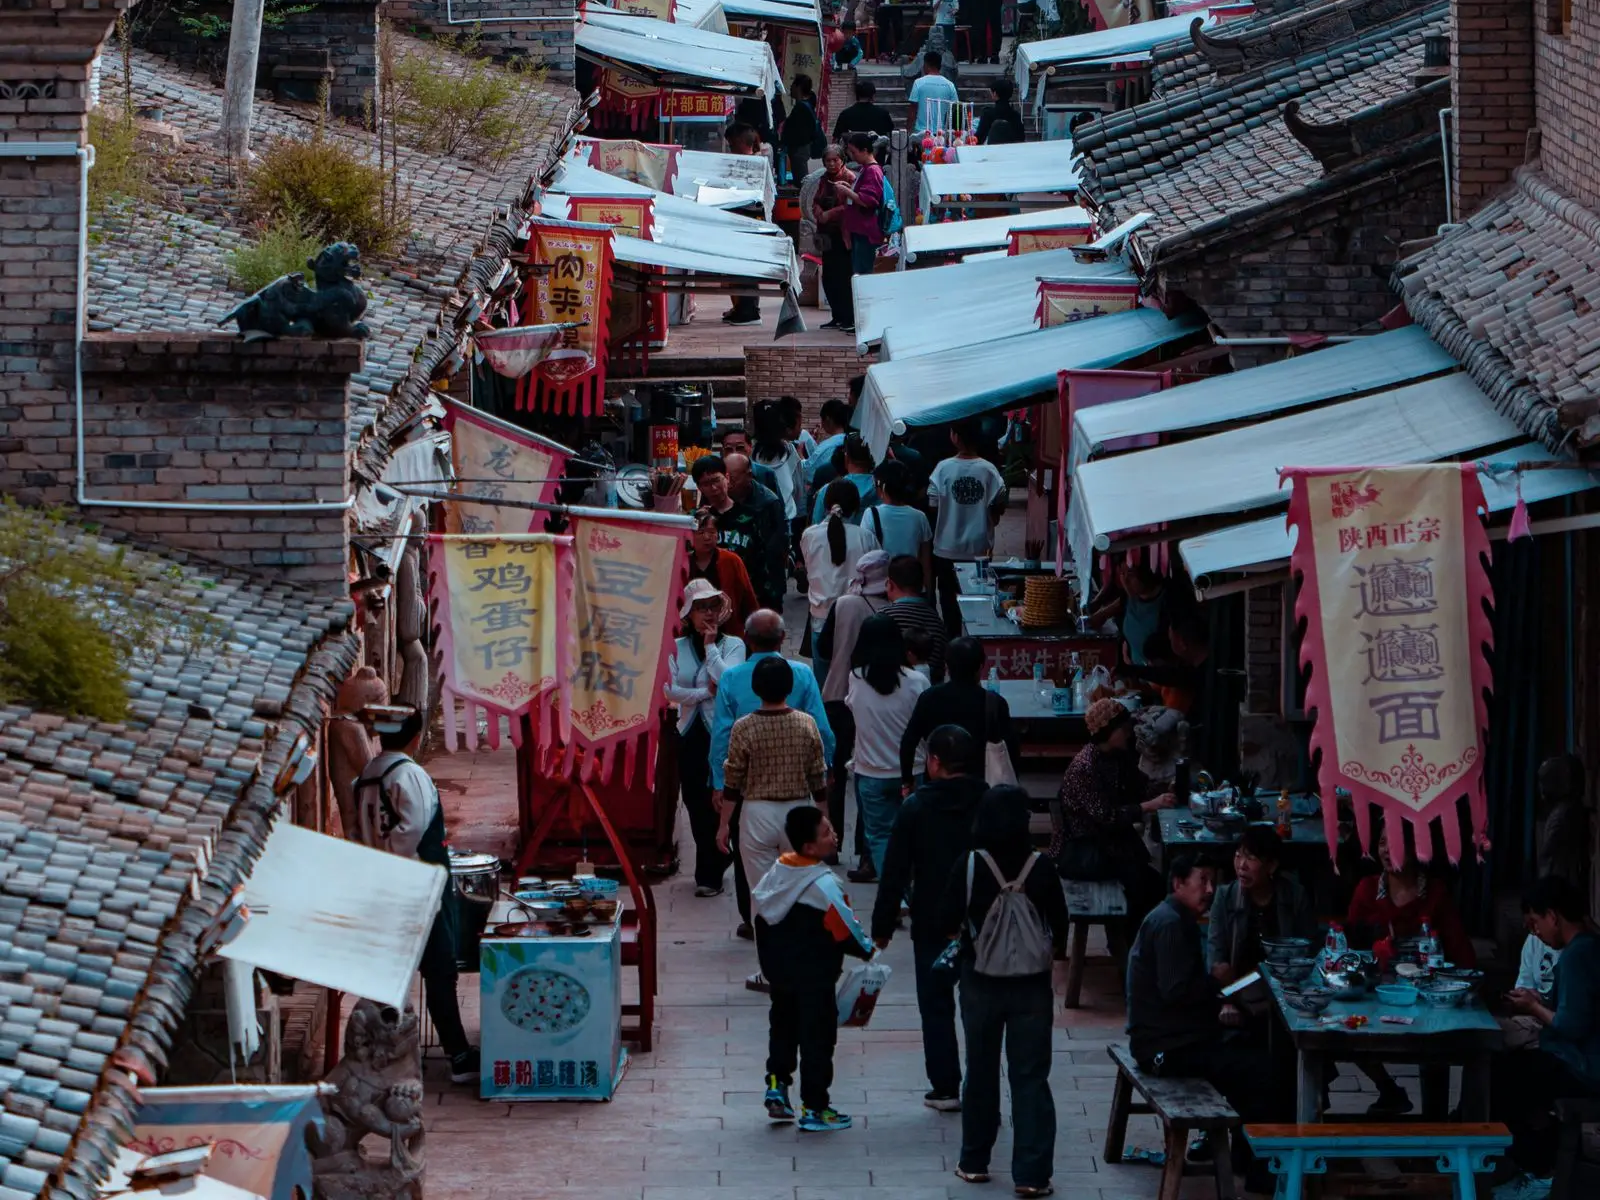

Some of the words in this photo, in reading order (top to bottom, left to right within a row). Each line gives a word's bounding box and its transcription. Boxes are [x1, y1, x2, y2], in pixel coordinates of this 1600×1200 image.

[1338, 518, 1441, 552] 陕西正宗
[468, 562, 538, 670] 鸡蛋仔
[571, 558, 656, 700] 豆腐脑
